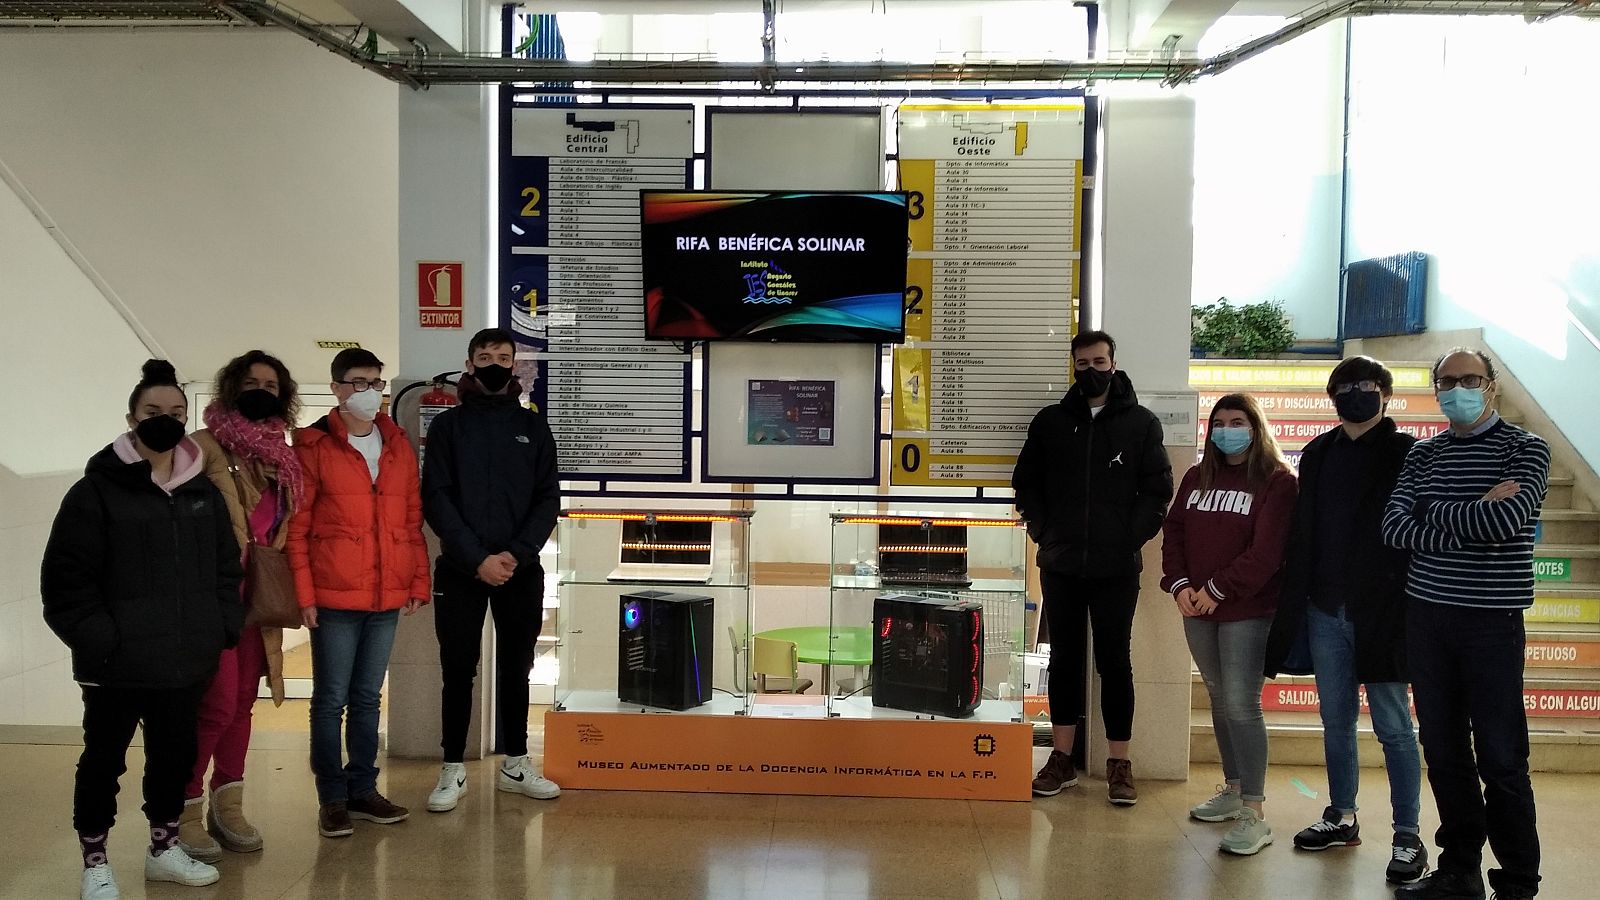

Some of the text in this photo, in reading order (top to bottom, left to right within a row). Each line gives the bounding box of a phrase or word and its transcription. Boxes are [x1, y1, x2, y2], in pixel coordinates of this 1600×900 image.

[566, 134, 608, 143] Edificio
[953, 137, 995, 145] Edificio
[520, 188, 540, 216] 2
[908, 191, 924, 220] 3
[676, 234, 865, 252] RIFA BENÉFICA SOLINAR
[523, 289, 537, 318] 1
[905, 286, 923, 314] 2
[422, 313, 460, 324] EXTINTOR
[907, 376, 919, 401] 1
[1277, 398, 1284, 408] Y
[1387, 400, 1407, 410] ARIO
[1283, 425, 1295, 436] TE
[1420, 428, 1428, 438] A
[902, 444, 920, 472] 0
[1186, 489, 1253, 515] PUMA
[1526, 604, 1580, 617] STANCIAS
[1526, 647, 1576, 661] PETUOSO
[1540, 696, 1564, 710] CON
[972, 770, 996, 779] F.P.
